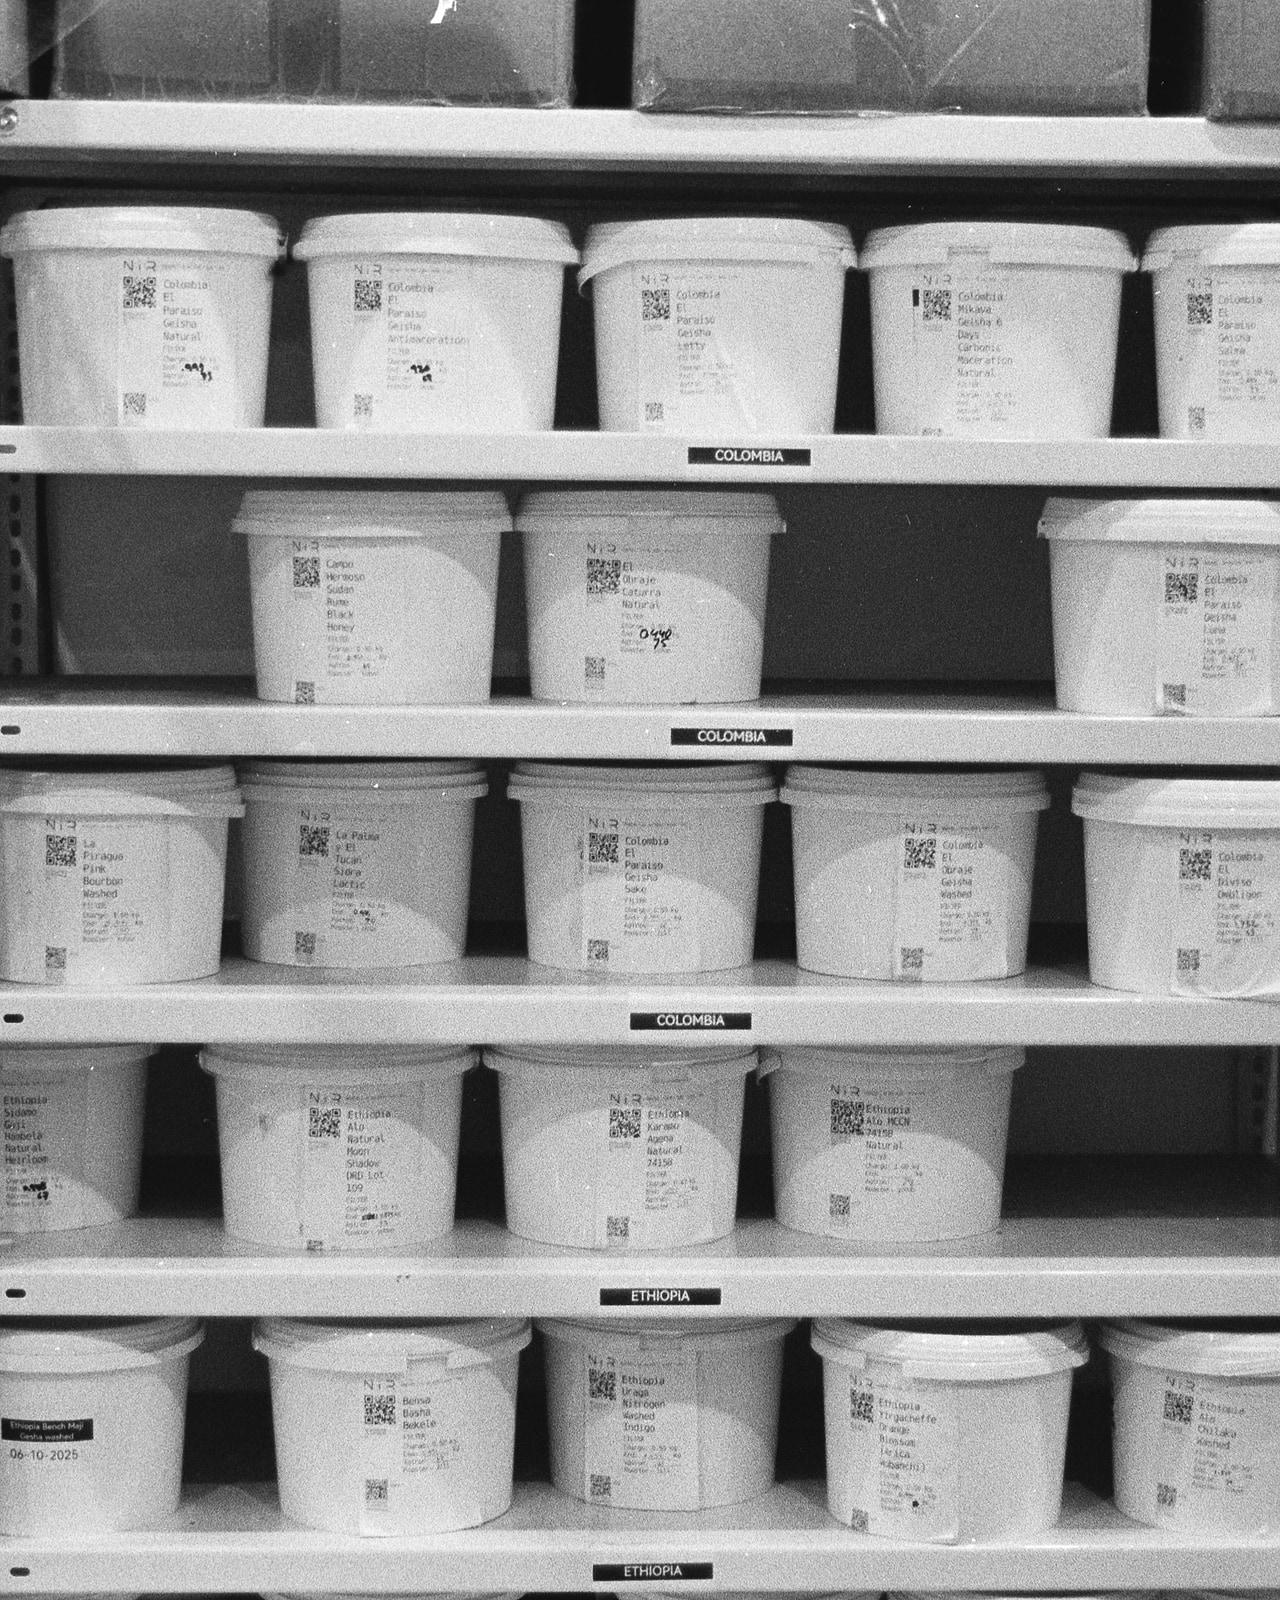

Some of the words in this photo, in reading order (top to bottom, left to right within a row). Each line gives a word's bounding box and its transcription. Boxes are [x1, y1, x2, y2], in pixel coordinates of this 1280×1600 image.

[164, 279, 208, 290] Colombia
[388, 282, 434, 293] Colombia
[163, 292, 174, 302] El
[388, 295, 399, 304] El
[676, 290, 720, 300] Colombia
[958, 292, 1003, 301] Colombia
[1219, 295, 1263, 304] Colombia
[163, 306, 203, 315] Paraiso
[676, 303, 686, 312] El
[387, 308, 426, 318] Paraiso
[163, 318, 197, 328] Geisha
[676, 316, 715, 325] Paraiso
[958, 317, 991, 327] Geisha
[388, 321, 421, 331] Geisha
[163, 332, 201, 341] Natural
[677, 329, 711, 338] Geisha
[958, 329, 979, 340] Days
[1219, 334, 1250, 342] Geisha
[958, 343, 1001, 352] Carbonic
[957, 368, 996, 377] Natural
[715, 449, 784, 463] COLOMBIA
[326, 560, 353, 569] Campo
[623, 562, 632, 571] El
[326, 573, 365, 581] Hermoso
[1205, 573, 1248, 584] Colombia
[327, 585, 354, 594] Sudan
[622, 601, 660, 609] Natural
[327, 610, 353, 618] Black
[1204, 613, 1236, 622] Geisha
[327, 623, 355, 633] Honey
[697, 730, 766, 743] COLOMBIA
[336, 832, 347, 840] La
[352, 831, 380, 841] Palma
[83, 840, 95, 848] La
[625, 836, 669, 846] Colombia
[942, 841, 984, 850] Colombia
[346, 843, 356, 851] El
[625, 849, 636, 857] El
[942, 853, 951, 862] El
[1218, 852, 1264, 862] Colombia
[336, 855, 362, 864] Tucan
[83, 864, 107, 873] Pink
[625, 861, 663, 870] Paraiso
[1218, 865, 1230, 874] El
[83, 877, 123, 885] Bourbon
[625, 873, 658, 882] Geisha
[1218, 878, 1252, 886] Diviso
[333, 879, 365, 889] Lactic
[941, 878, 972, 887] Geisha
[83, 890, 118, 898] Washed
[941, 890, 972, 898] Washed
[656, 1014, 725, 1026] COLOMBIA
[4, 1096, 48, 1104] Ethiopia
[4, 1108, 37, 1117] Sidamo
[866, 1104, 911, 1115] Ethiopia
[347, 1110, 391, 1119] Ethiopia
[648, 1110, 690, 1119] Ethiopia
[348, 1123, 365, 1132] Alo
[5, 1132, 43, 1141] Hambela
[347, 1134, 385, 1143] Natural
[5, 1144, 42, 1152] Natural
[866, 1141, 903, 1150] Natural
[347, 1148, 370, 1156] Moon
[647, 1146, 683, 1155] Natural
[5, 1155, 49, 1164] Heirloom
[346, 1159, 380, 1168] Shadow
[647, 1159, 673, 1167] 74158
[368, 1171, 384, 1180] Lot
[347, 1184, 363, 1192] 109
[631, 1290, 690, 1302] ETHIOPIA
[622, 1375, 665, 1385] Ethiopia
[403, 1397, 431, 1405] Bensa
[623, 1400, 665, 1409] Nitrogen
[879, 1398, 920, 1411] Ethiopia
[1200, 1401, 1244, 1414] Ethiopia
[403, 1409, 431, 1418] Basha
[623, 1411, 655, 1420] Washed
[10, 1421, 39, 1431] Ethiopia
[68, 1422, 84, 1430] Maji
[403, 1421, 436, 1429] Bekele
[624, 1423, 655, 1432] Indigo
[880, 1434, 915, 1447] Blossom
[1197, 1438, 1230, 1449] Washed
[10, 1448, 78, 1460] 06-10-2025
[624, 1565, 683, 1577] ETHIOPIA
